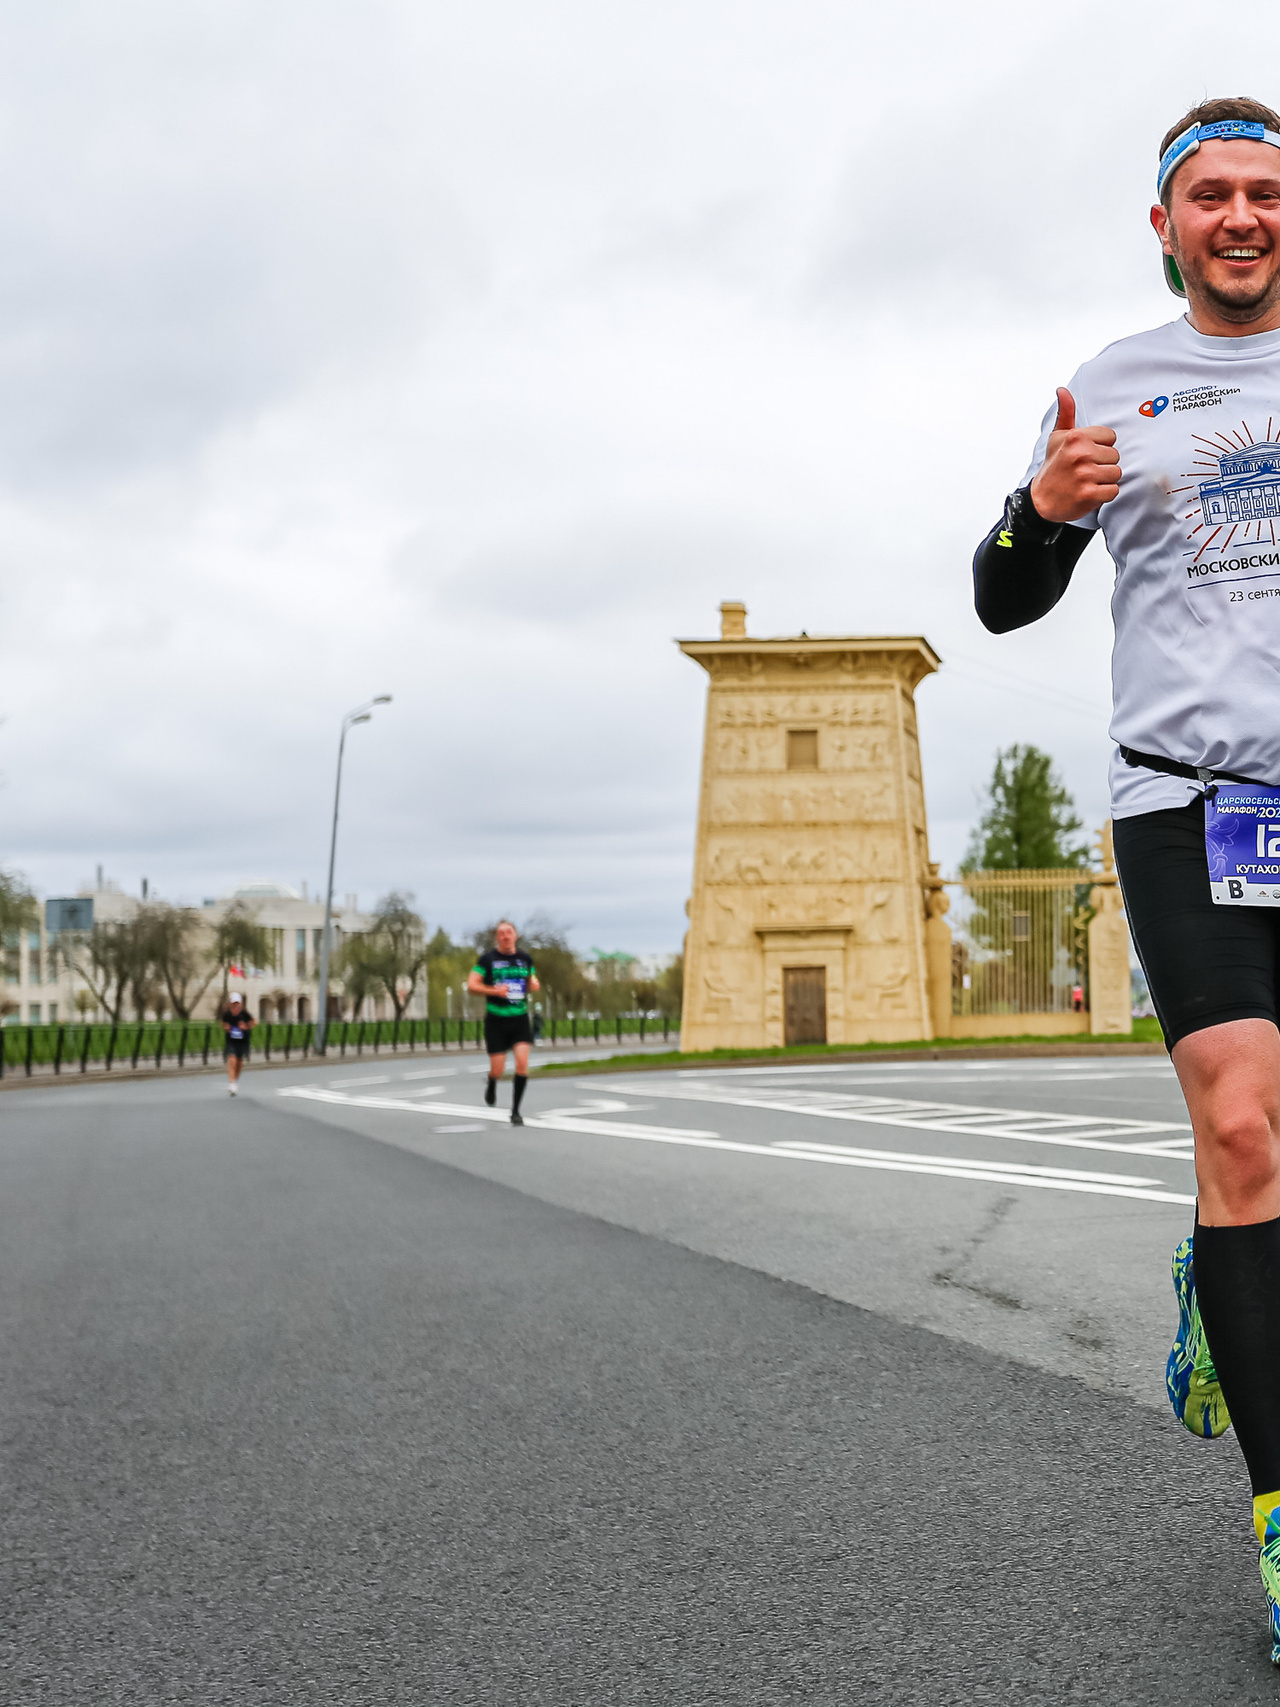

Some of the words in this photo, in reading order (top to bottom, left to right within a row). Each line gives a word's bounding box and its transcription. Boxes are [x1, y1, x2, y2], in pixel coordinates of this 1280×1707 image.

[1174, 398, 1222, 412] МАРАФОН
[1229, 591, 1244, 602] 23
[1216, 806, 1258, 815] МАРАФОН
